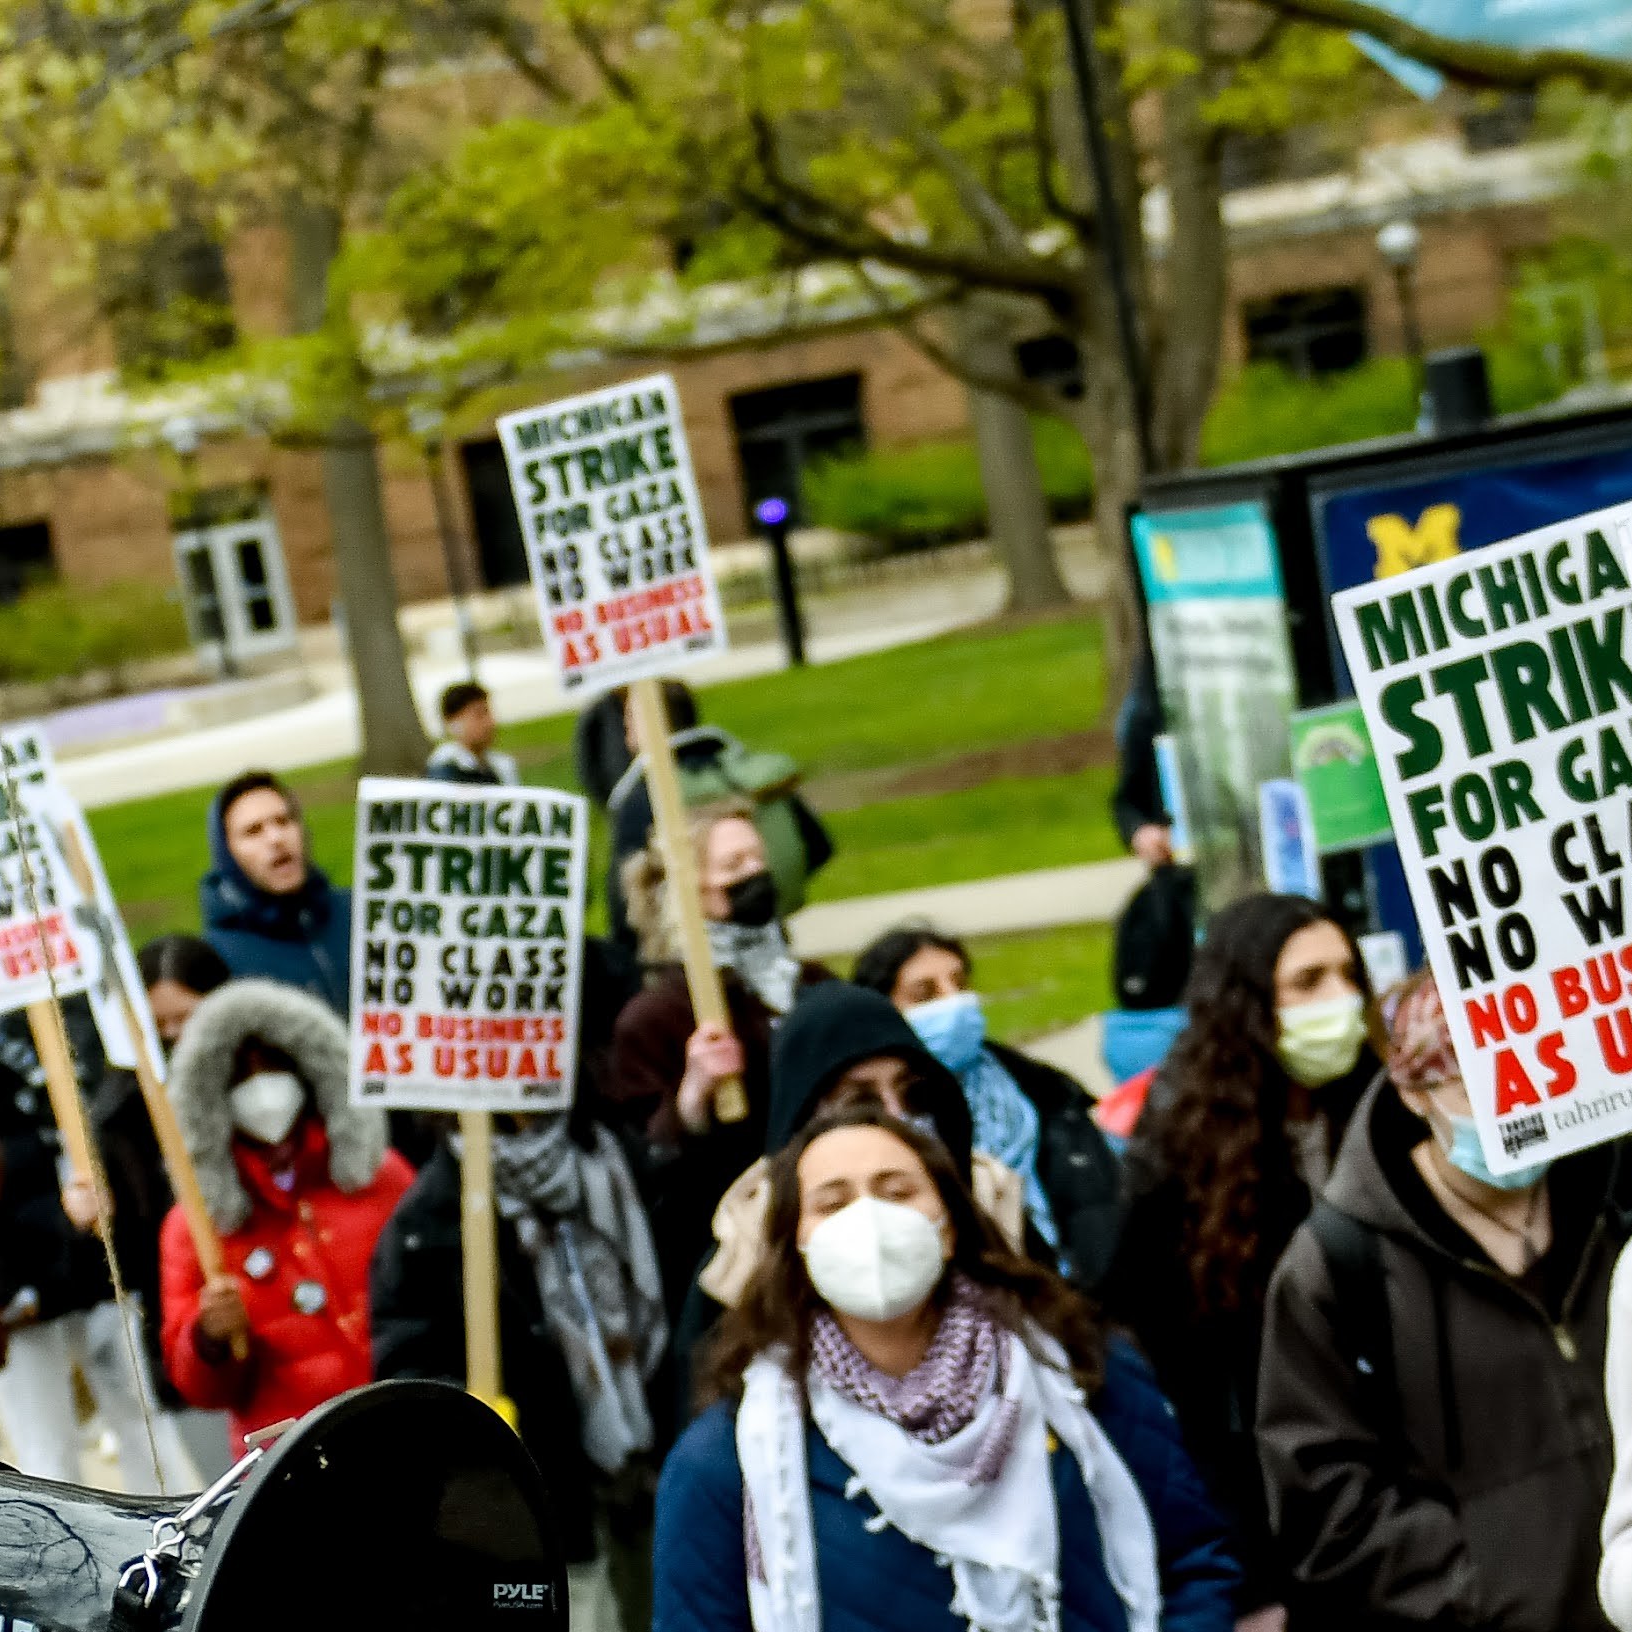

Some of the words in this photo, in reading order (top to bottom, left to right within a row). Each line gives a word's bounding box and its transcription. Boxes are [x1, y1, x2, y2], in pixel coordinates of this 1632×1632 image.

[525, 424, 678, 505] STRIKE
[534, 502, 592, 543] FOR
[606, 479, 684, 523] GAZA
[599, 513, 693, 562] CLASS
[1367, 503, 1462, 579] M
[1353, 529, 1632, 672] MICHIGA
[564, 633, 601, 669] AS
[616, 604, 713, 654] USUAL
[368, 800, 574, 839] MICHIGAN
[1405, 759, 1546, 857] FOR
[366, 841, 571, 899] STRIKE
[1428, 845, 1522, 928] NO
[365, 900, 442, 937] FOR
[459, 903, 567, 939] GAZA
[1446, 911, 1539, 991] NO
[364, 939, 416, 972] NO
[441, 945, 569, 978] CLASS
[363, 976, 414, 1006] NO
[439, 979, 564, 1013] WORK
[1466, 982, 1539, 1048] NO
[362, 1011, 403, 1038] NO
[417, 1013, 565, 1044] BUSINESS
[363, 1042, 414, 1075] AS
[431, 1046, 563, 1081] USUAL
[1495, 1031, 1577, 1117] AS
[493, 1583, 544, 1601] PYLE
